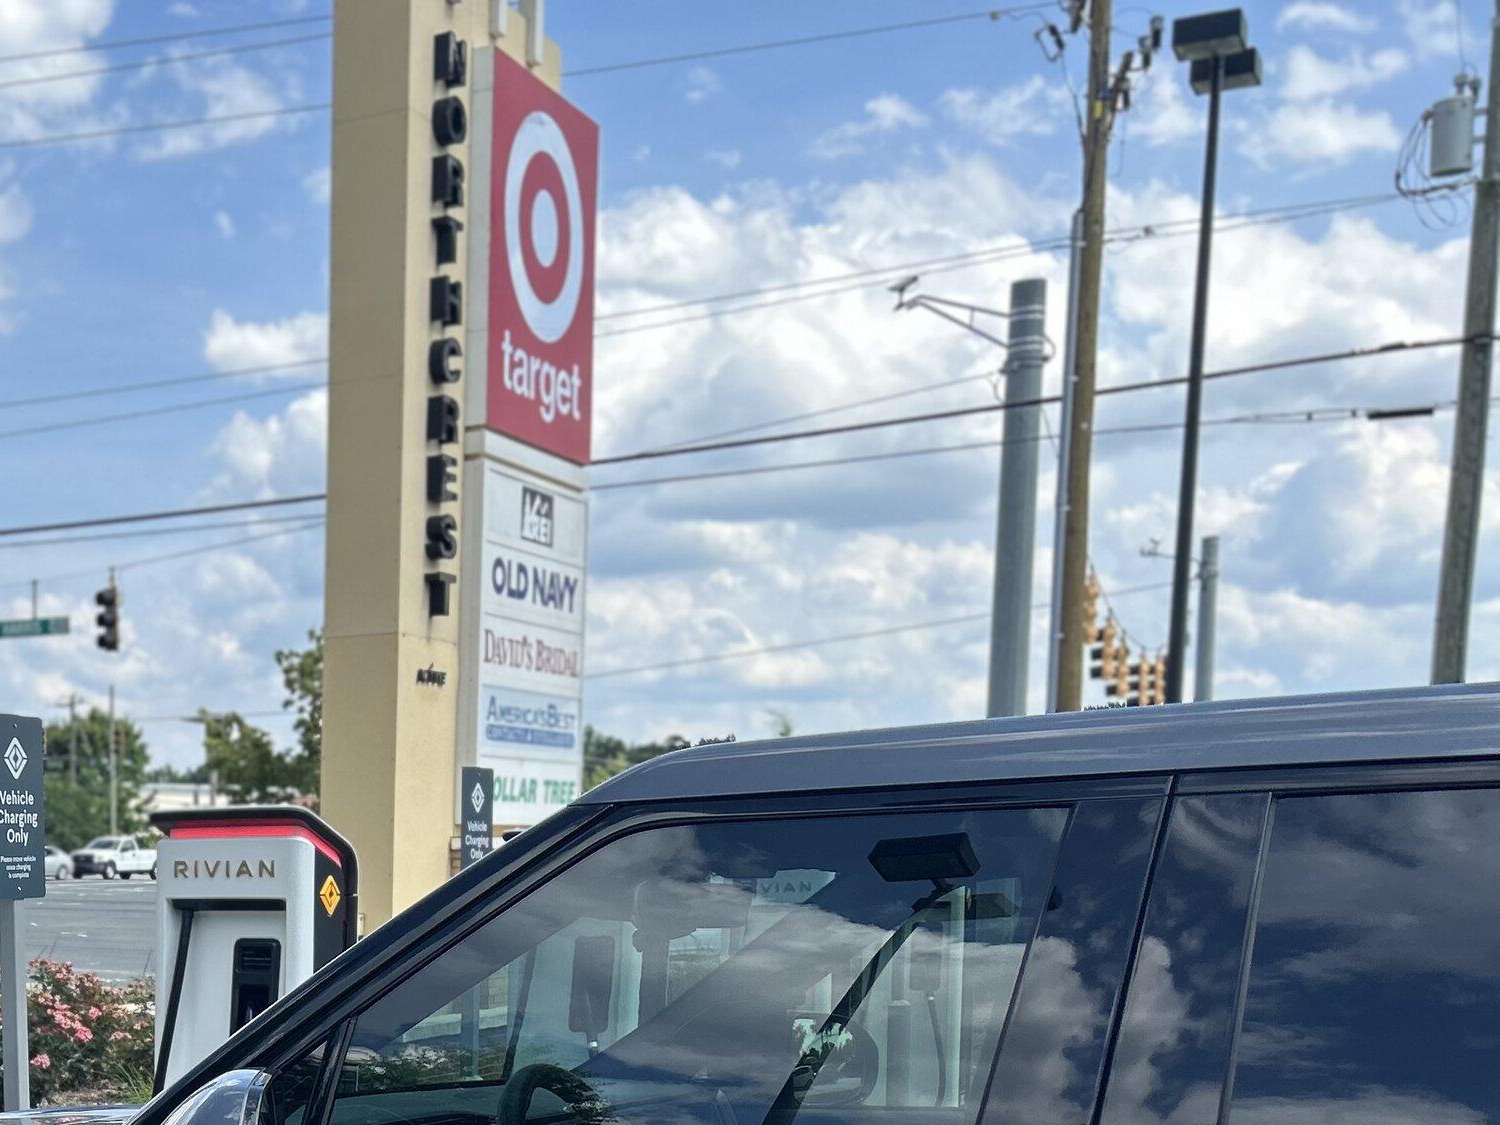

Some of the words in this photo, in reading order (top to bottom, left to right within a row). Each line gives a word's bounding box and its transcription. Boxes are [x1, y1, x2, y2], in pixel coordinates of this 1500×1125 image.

[425, 29, 468, 618] NORTHCREST
[501, 329, 582, 422] target
[491, 557, 529, 600] OLD
[533, 566, 578, 614] NAVY
[0, 790, 34, 806] Vehicle
[493, 775, 537, 803] OLLAR
[543, 779, 575, 805] TREE
[7, 828, 29, 847] Only
[173, 859, 275, 879] RIVIAN
